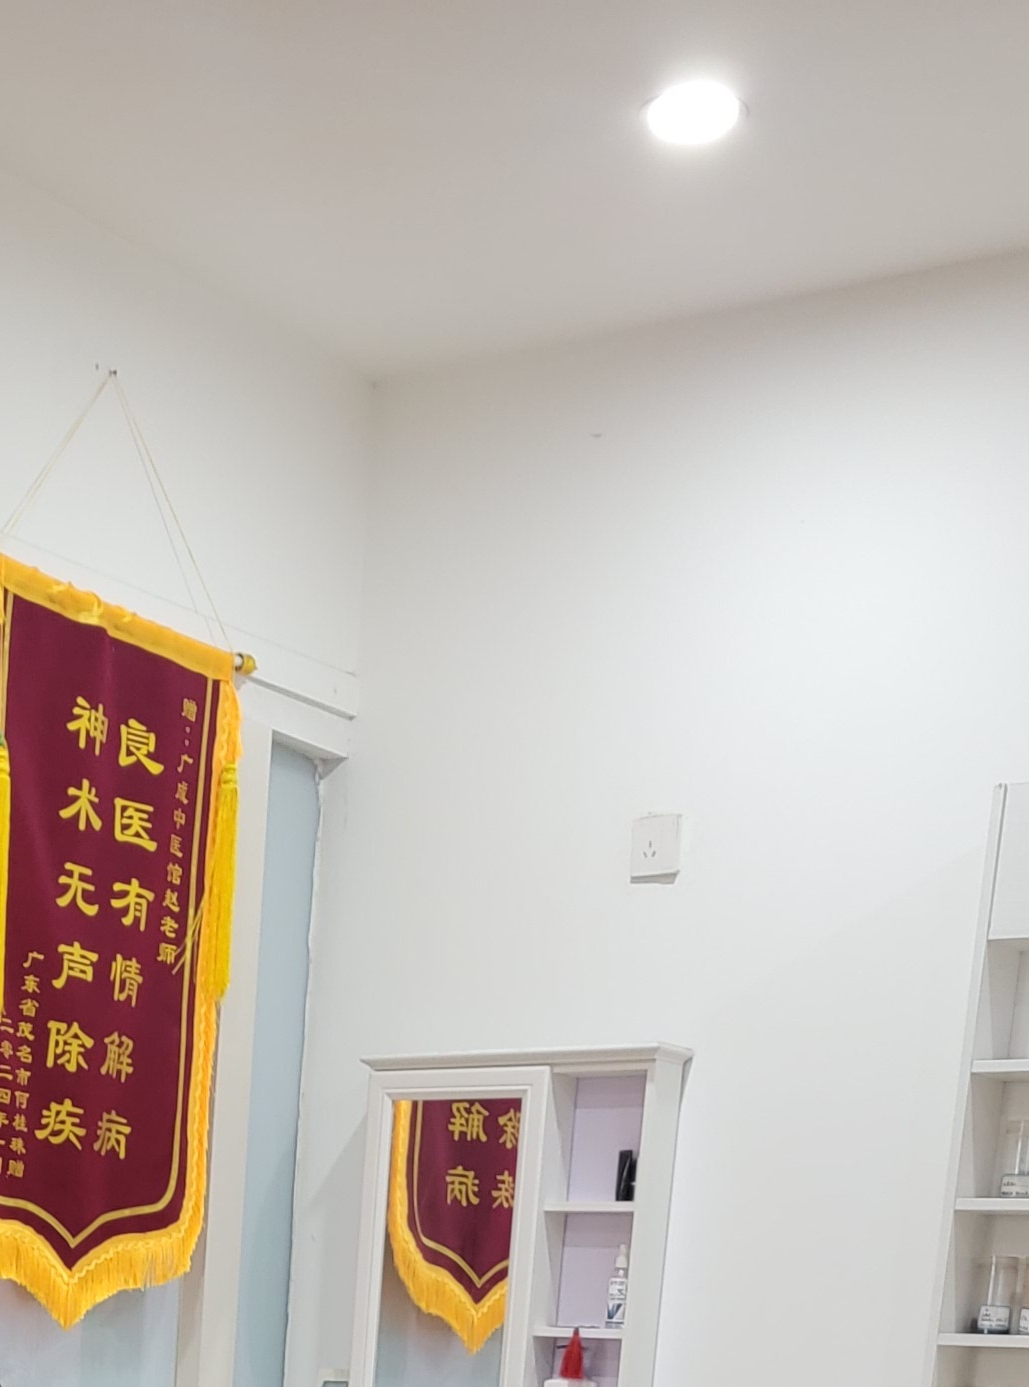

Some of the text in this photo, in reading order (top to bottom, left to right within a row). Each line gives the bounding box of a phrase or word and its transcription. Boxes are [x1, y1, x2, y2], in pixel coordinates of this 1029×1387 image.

[34, 696, 109, 1150] 神术无声除疾
[94, 718, 165, 1159] 良医有情解病
